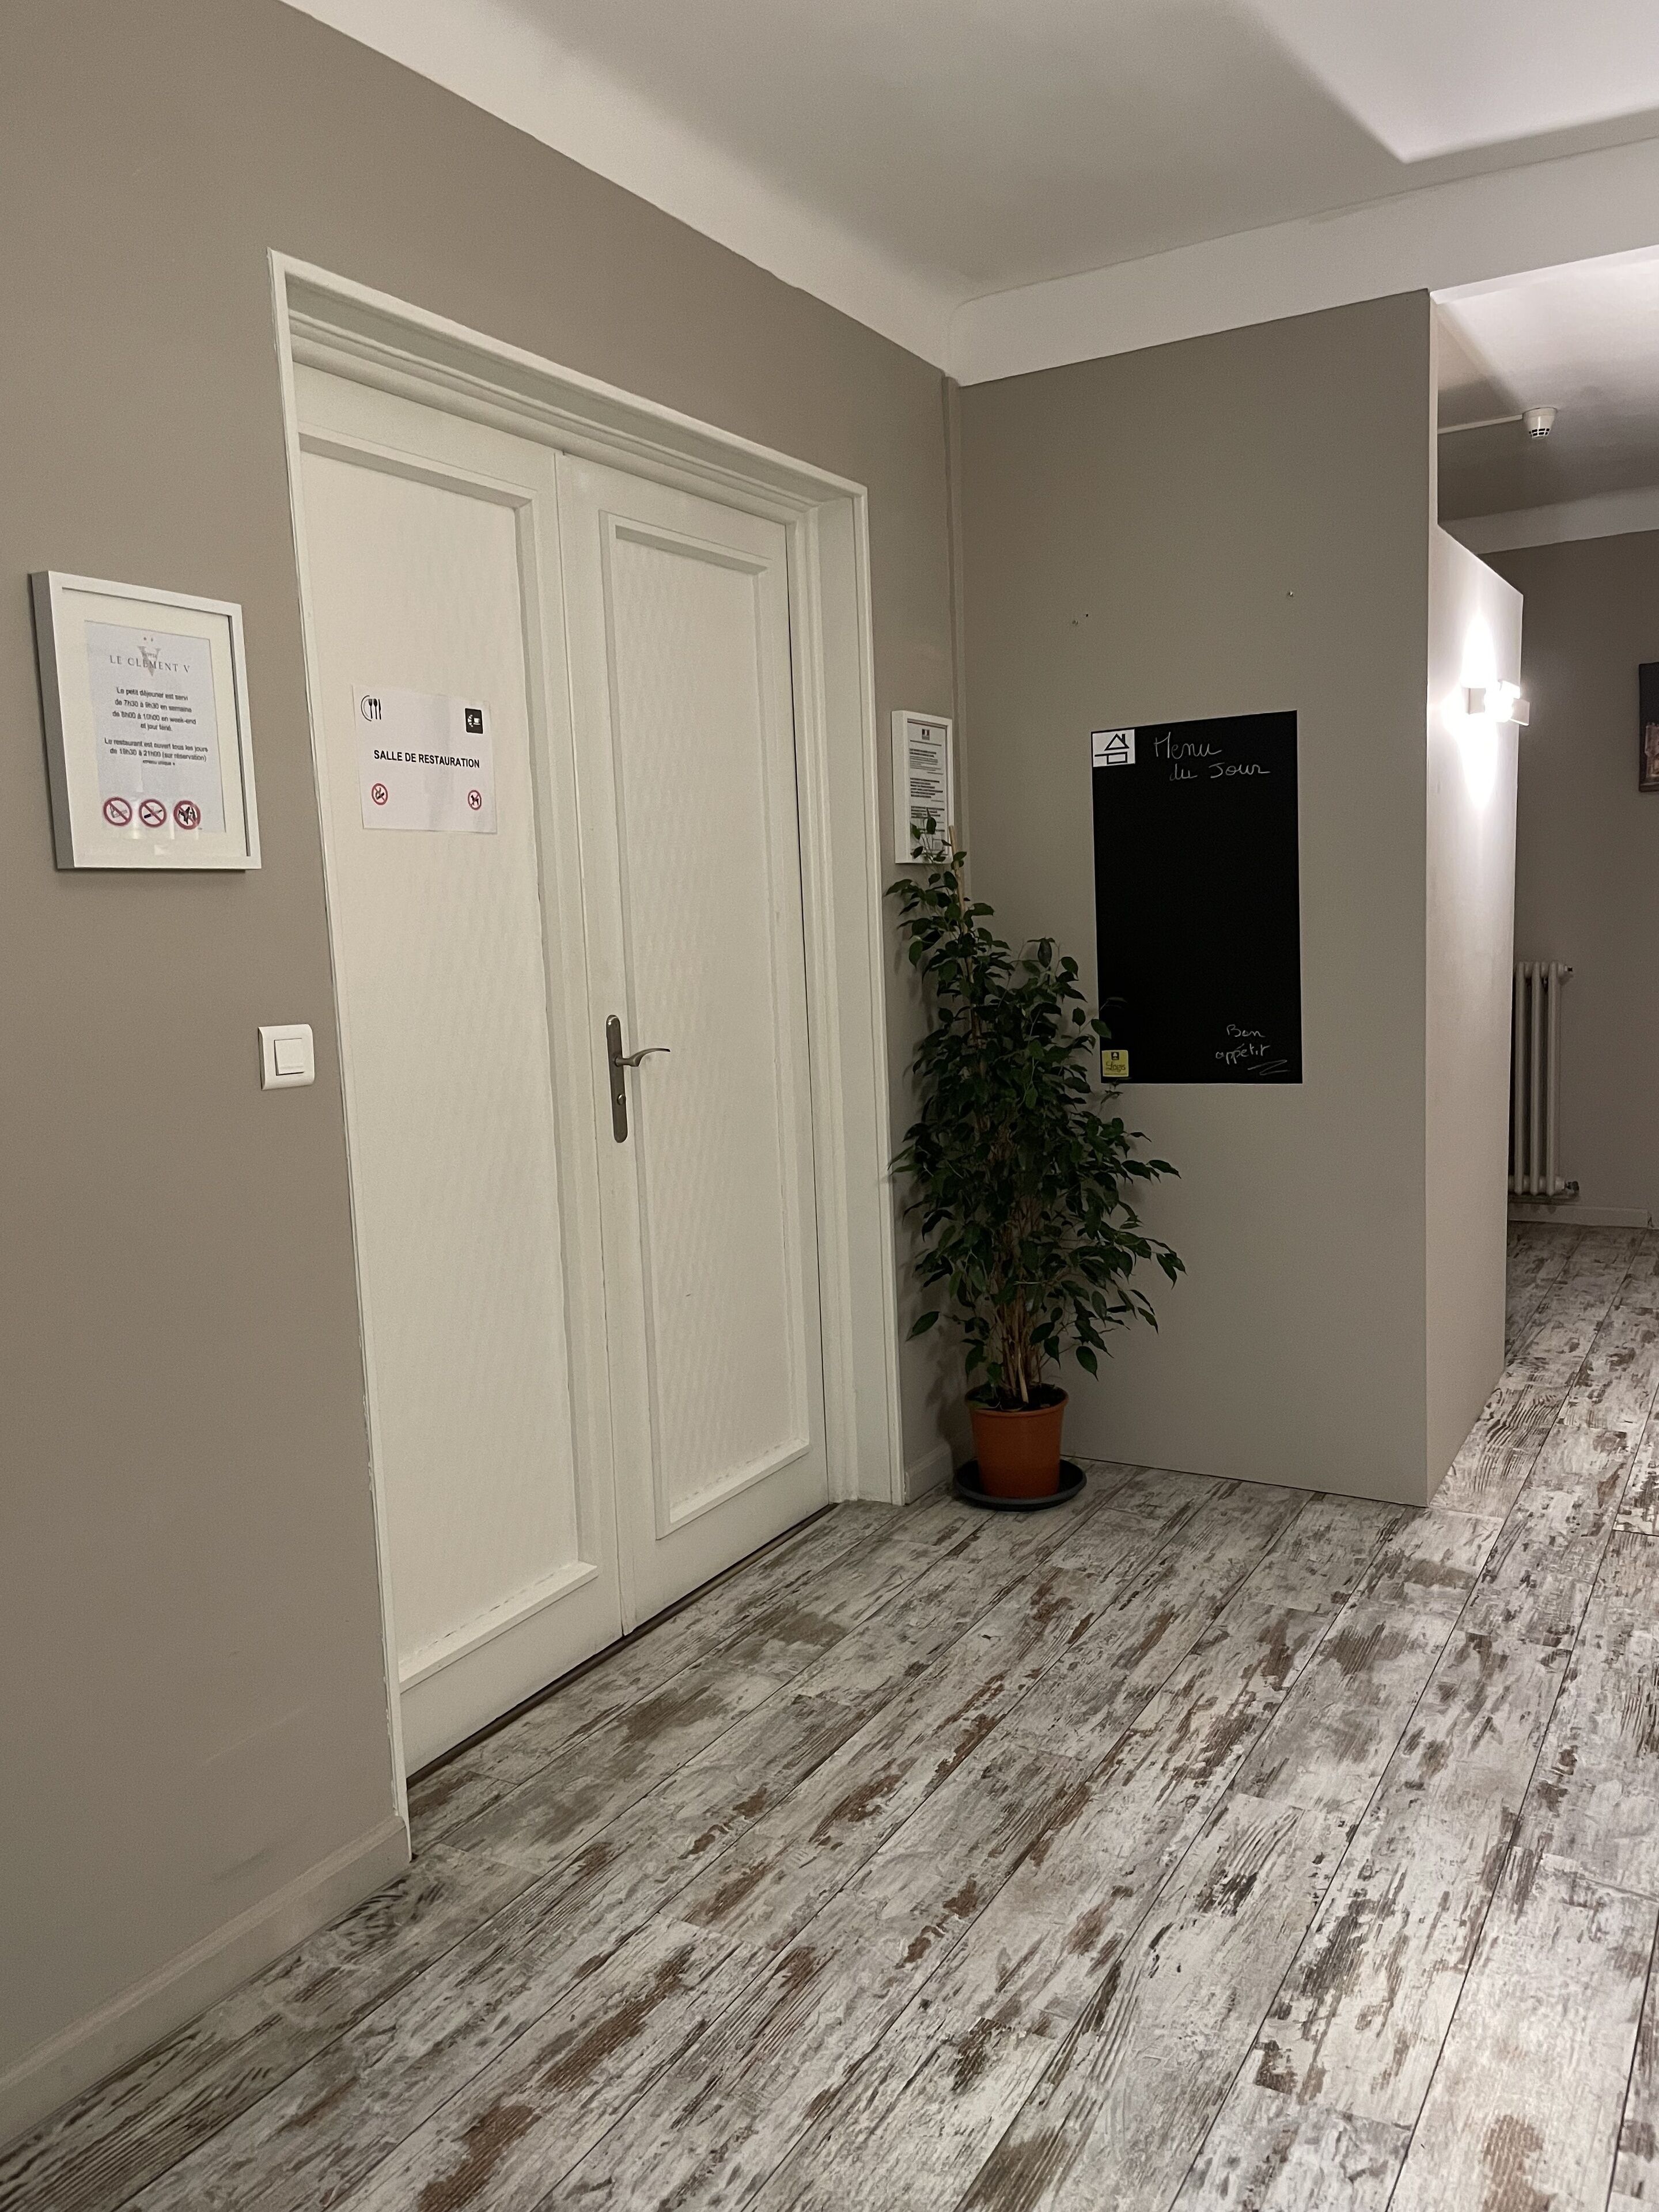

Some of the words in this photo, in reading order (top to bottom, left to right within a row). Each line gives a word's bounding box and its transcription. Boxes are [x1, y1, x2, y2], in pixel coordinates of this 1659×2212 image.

[109, 654, 122, 665] LE
[183, 664, 190, 673] V
[1153, 732, 1222, 759] Menu
[374, 750, 403, 762] SALLE
[405, 752, 416, 763] DE
[418, 754, 480, 768] RESTAURATION
[1226, 1024, 1266, 1037] Bon
